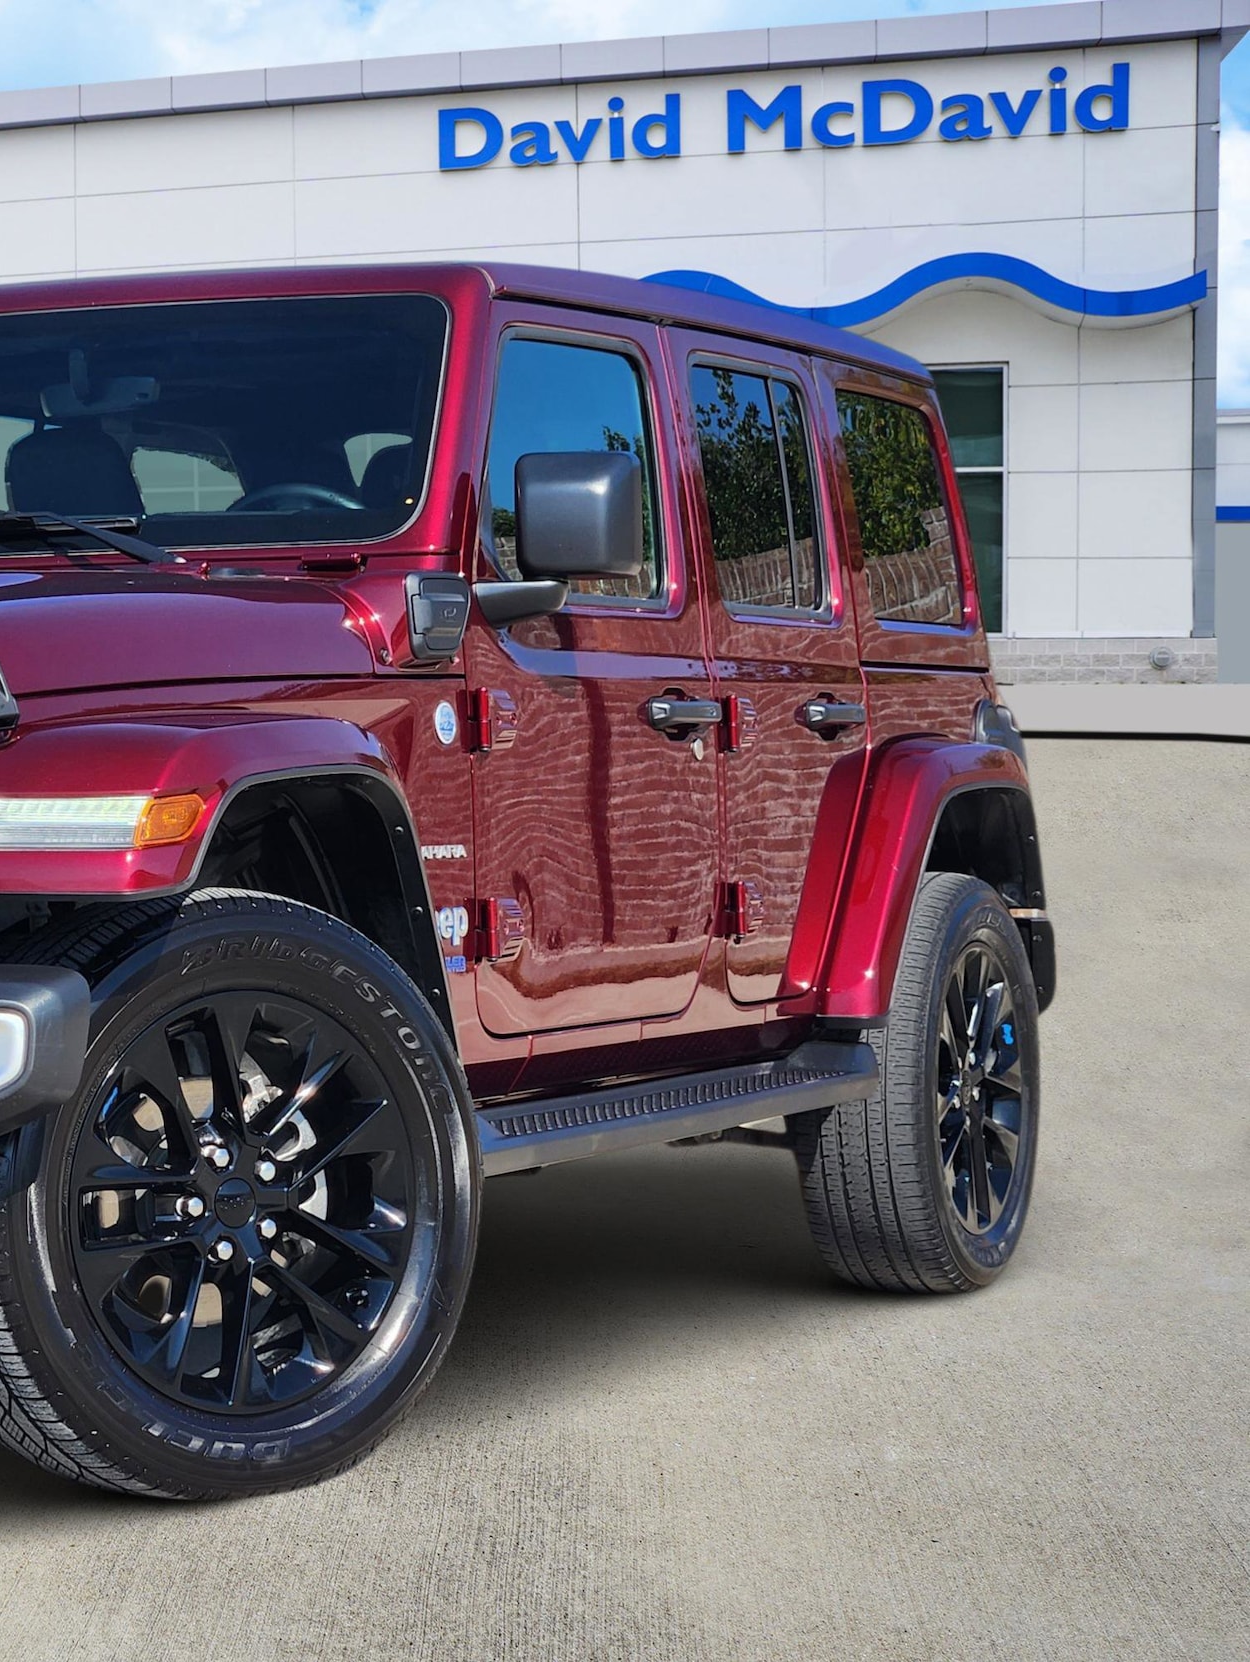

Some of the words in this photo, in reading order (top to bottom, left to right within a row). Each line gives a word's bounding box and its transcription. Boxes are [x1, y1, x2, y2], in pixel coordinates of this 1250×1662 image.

[438, 93, 681, 172] David
[726, 62, 1131, 154] McDavid
[421, 844, 467, 860] AHARA
[435, 906, 470, 947] ep
[180, 935, 453, 1109] BRIDGESTONE
